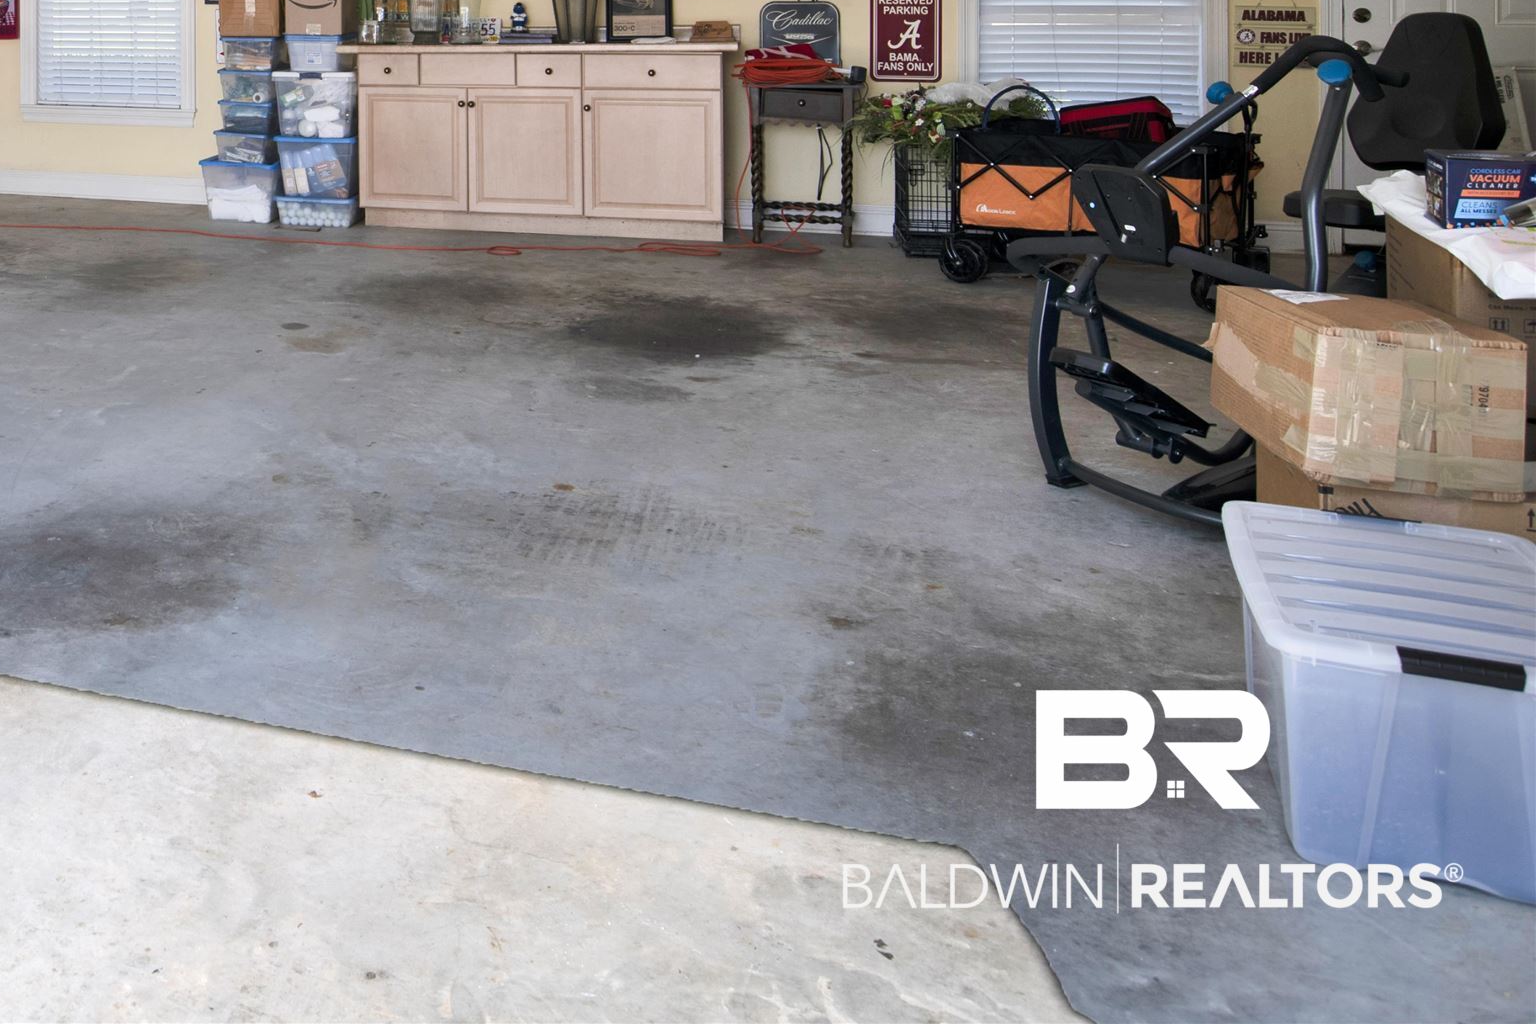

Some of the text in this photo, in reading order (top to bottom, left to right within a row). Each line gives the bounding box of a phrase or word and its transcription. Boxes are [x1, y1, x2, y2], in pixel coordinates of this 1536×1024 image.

[883, 6, 929, 15] PARKING
[1241, 9, 1306, 22] ALABAMA
[765, 9, 835, 31] Cadillac
[1260, 31, 1287, 44] FANS
[889, 53, 920, 62] BAMA
[1239, 51, 1272, 64] HERE
[877, 62, 935, 72] FANS ONLY
[1469, 174, 1521, 183] VACUUM
[1461, 201, 1498, 209] CLEANS
